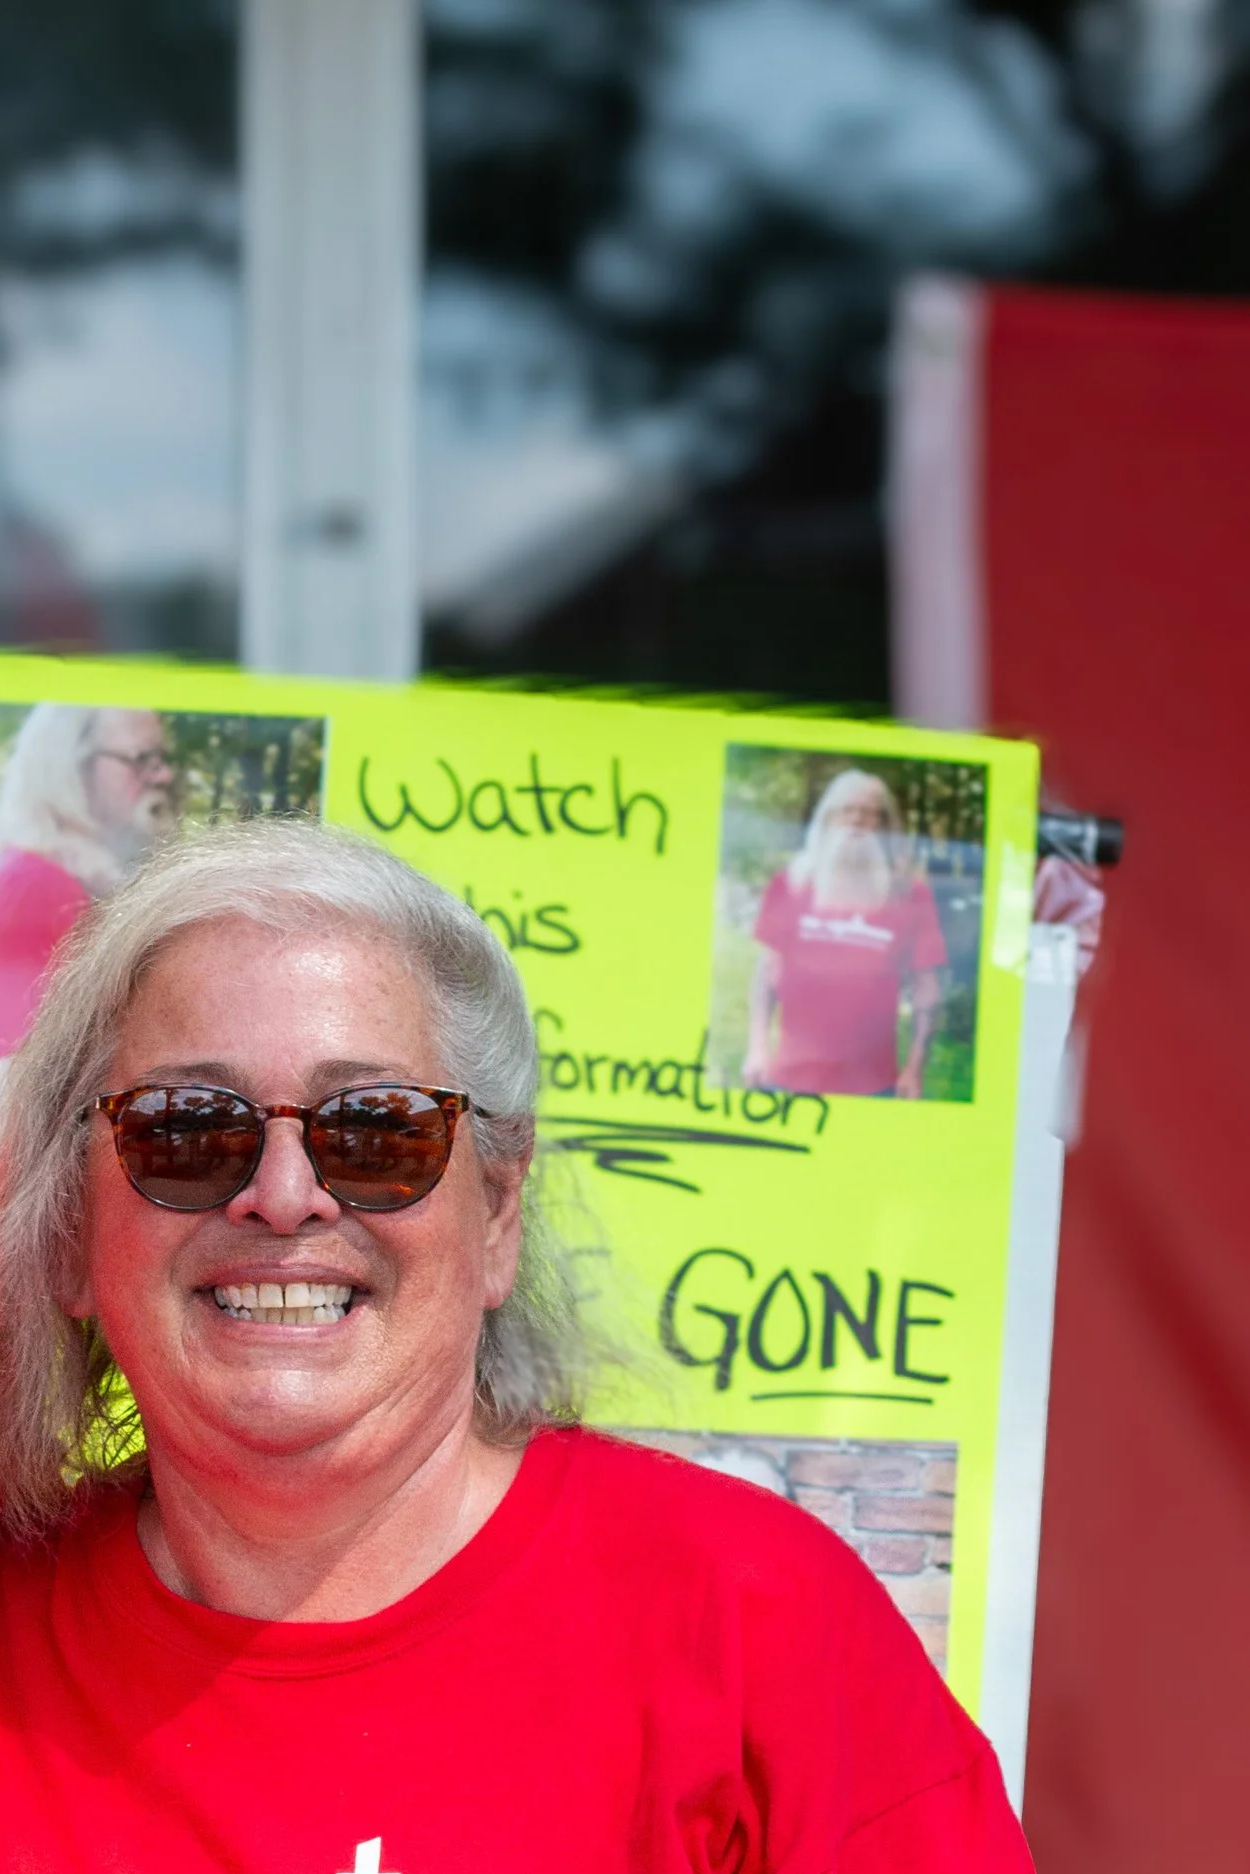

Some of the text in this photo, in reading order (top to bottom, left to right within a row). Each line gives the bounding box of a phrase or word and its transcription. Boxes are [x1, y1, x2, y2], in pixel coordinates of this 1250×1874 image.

[358, 752, 668, 855] Watch
[464, 884, 581, 954] his
[534, 1008, 830, 1135] formation
[658, 1247, 956, 1393] GONE
